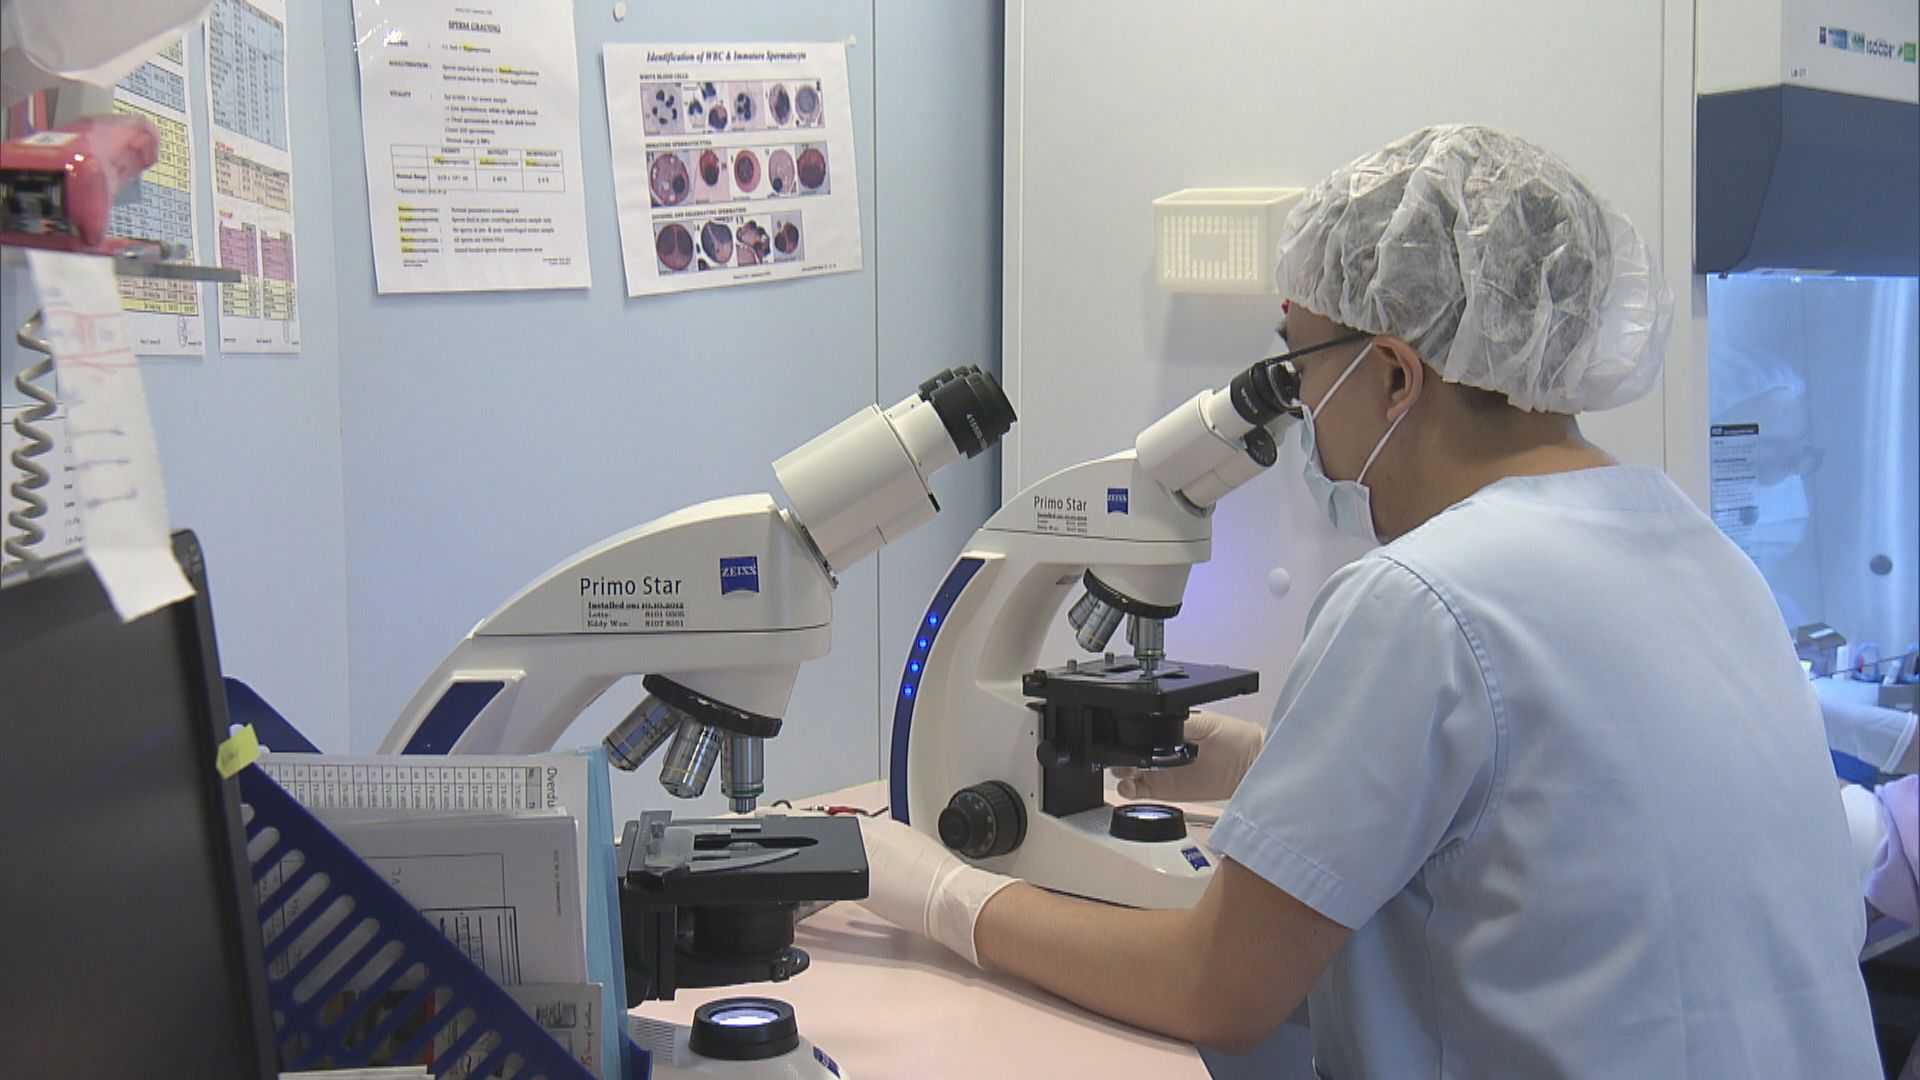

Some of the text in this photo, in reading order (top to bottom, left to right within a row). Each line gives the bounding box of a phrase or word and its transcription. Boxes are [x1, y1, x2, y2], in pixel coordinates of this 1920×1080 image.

[646, 51, 695, 63] Identification
[696, 51, 704, 63] of
[706, 51, 723, 61] WBC
[733, 51, 765, 61] Immature
[766, 51, 807, 62] Spermatocyte
[1033, 495, 1088, 512] Primo Star
[721, 564, 757, 577] ZEISS
[579, 575, 683, 596] Primo Star
[587, 601, 625, 610] Installed
[625, 602, 640, 610] on:
[587, 620, 608, 629] Eddy
